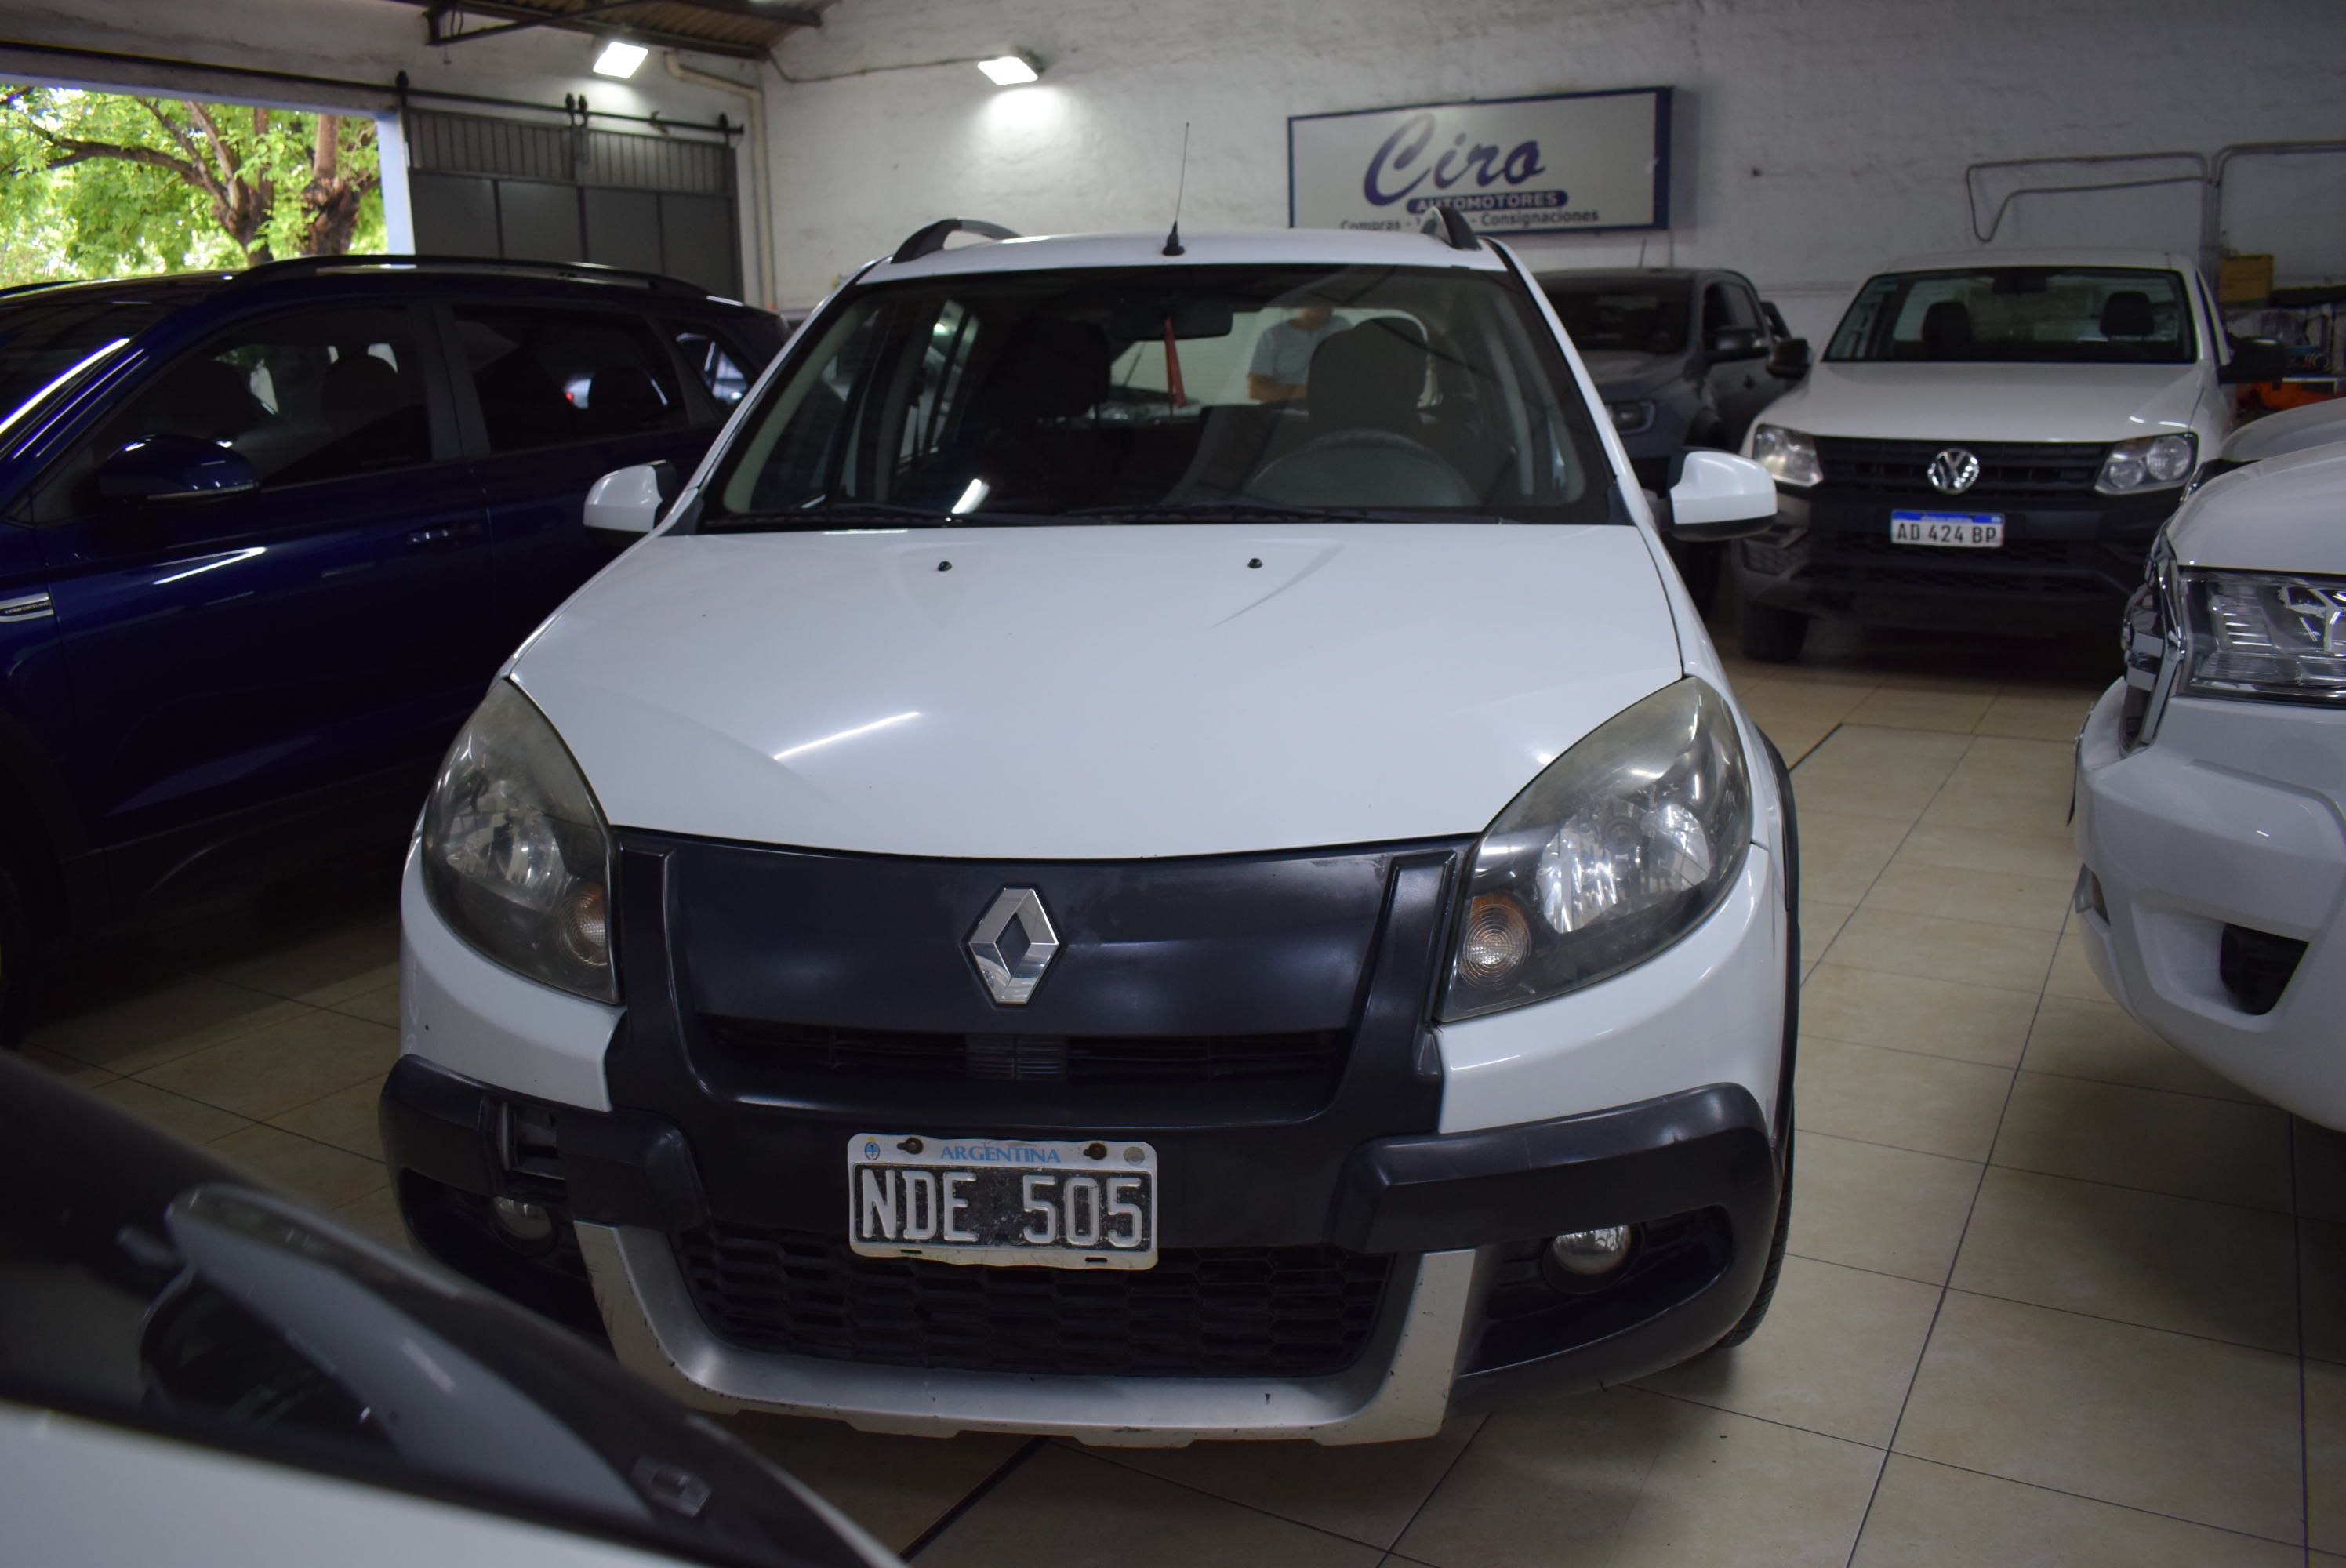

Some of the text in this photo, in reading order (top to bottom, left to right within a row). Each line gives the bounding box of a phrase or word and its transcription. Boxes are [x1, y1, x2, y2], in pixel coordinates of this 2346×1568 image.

[1364, 113, 1545, 206] Ciro
[1416, 192, 1558, 213] AUTOMOTORES
[1481, 209, 1599, 228] Consignaciones
[1898, 524, 1996, 543] AD 424 BP
[941, 1145, 1061, 1164] ARGENTINA
[862, 1168, 1143, 1247] NDE 505
